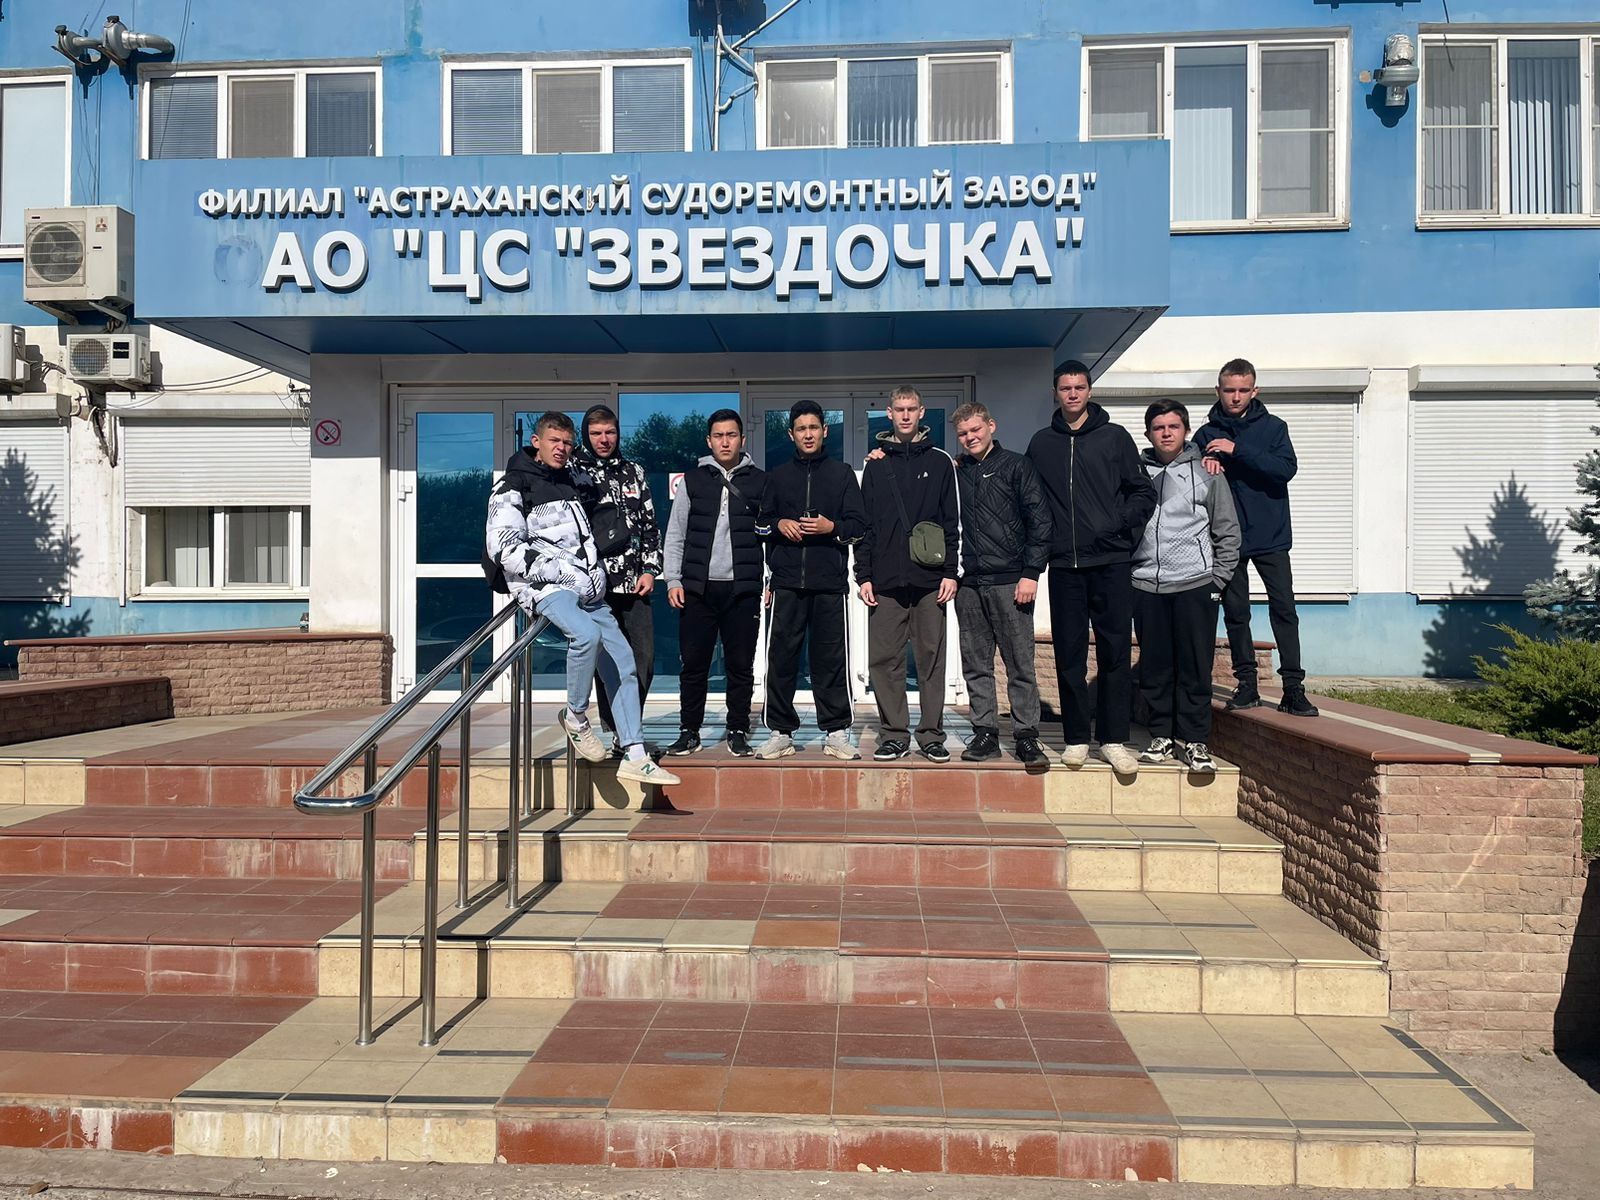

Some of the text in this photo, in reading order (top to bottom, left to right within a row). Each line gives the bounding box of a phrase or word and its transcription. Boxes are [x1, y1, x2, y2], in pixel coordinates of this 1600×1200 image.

[198, 168, 1097, 215] ФИЛИАЛ "АСТРАХАНСКИЙ СУДОРЕМОНТНЫЙ ЗАВОД"
[261, 216, 1084, 300] АО "ЦС "ЗВЕЗДОЧКА"
[640, 763, 656, 775] N
